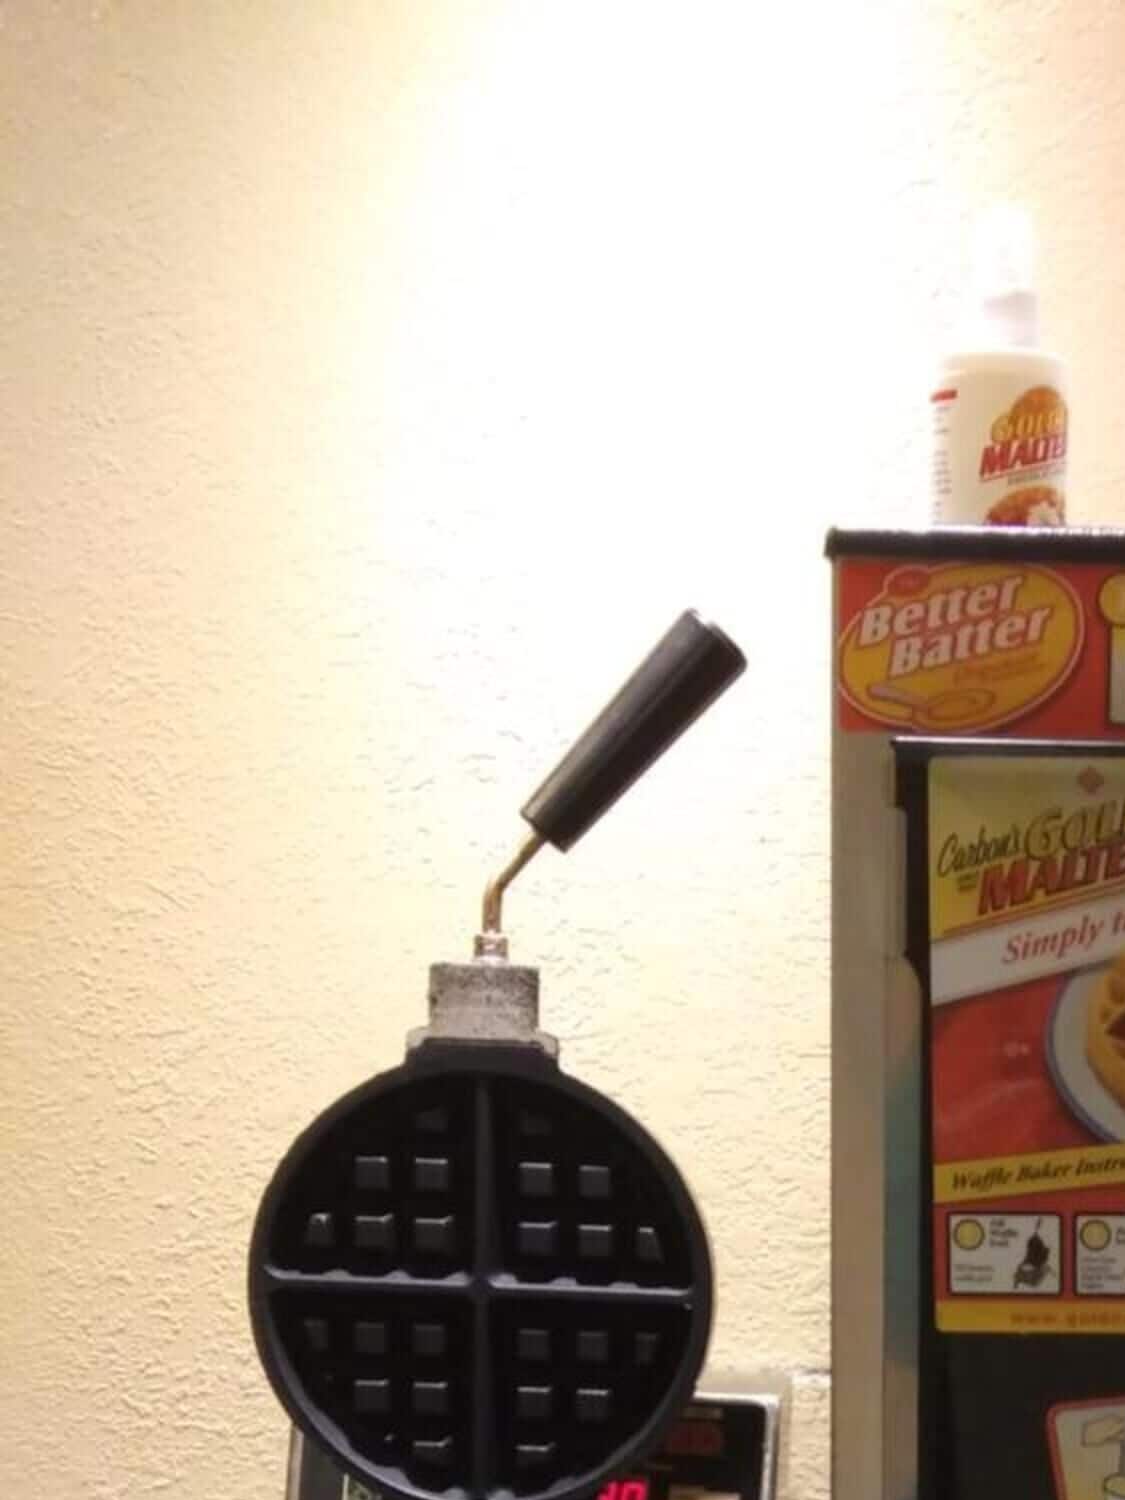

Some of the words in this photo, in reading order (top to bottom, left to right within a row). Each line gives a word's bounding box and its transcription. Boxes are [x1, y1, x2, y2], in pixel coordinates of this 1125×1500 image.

[859, 576, 1024, 646] Better
[890, 607, 1050, 677] Batter
[1002, 915, 1103, 965] Simply
[952, 1166, 1013, 1192] Waffle
[1016, 1158, 1074, 1183] Baker
